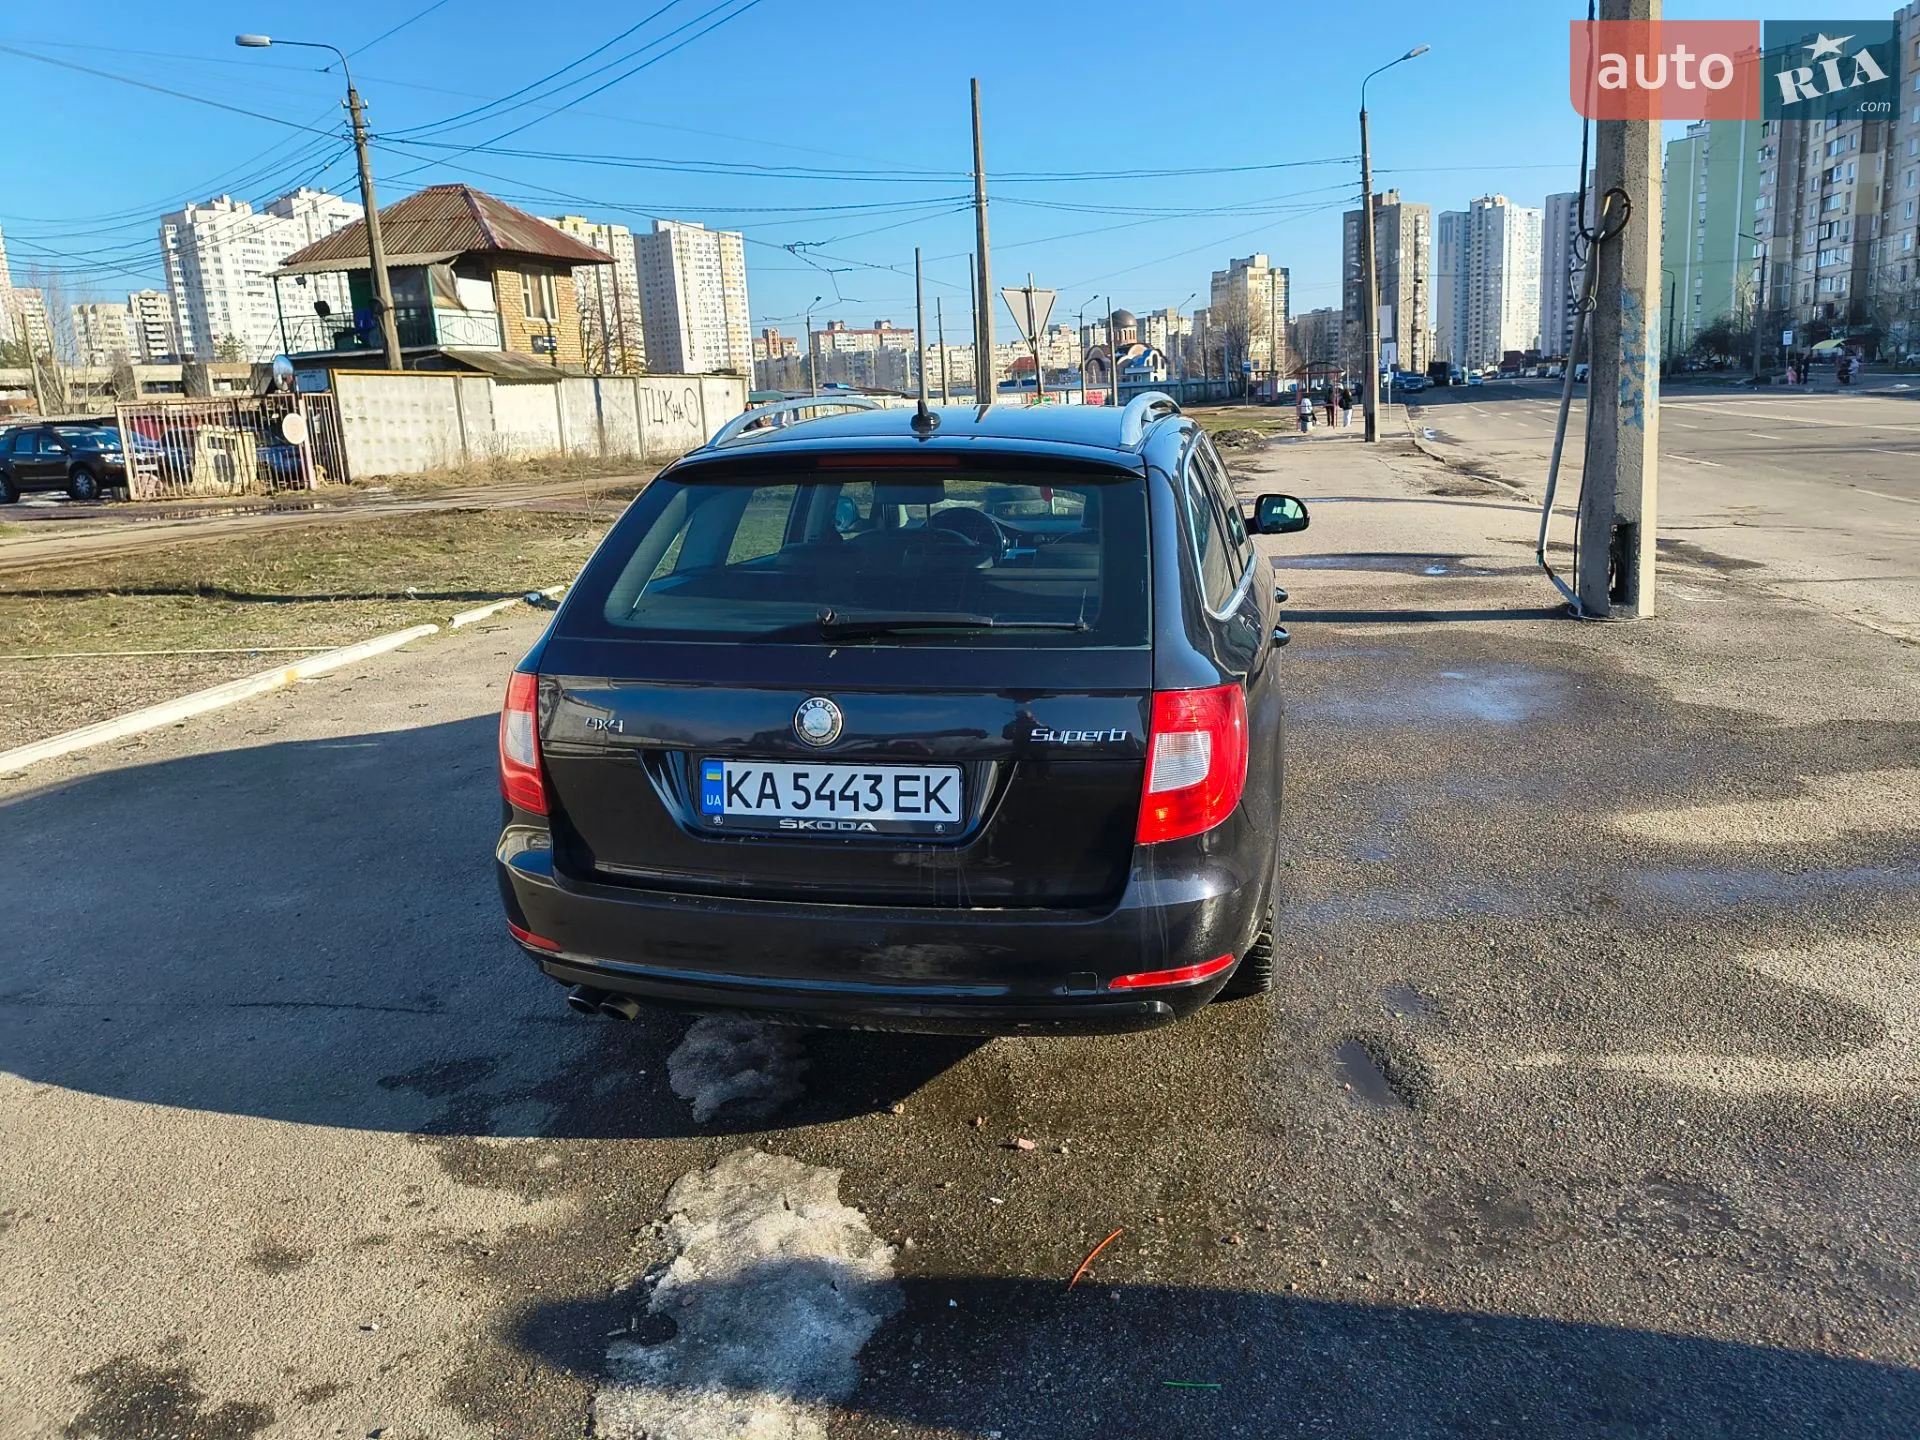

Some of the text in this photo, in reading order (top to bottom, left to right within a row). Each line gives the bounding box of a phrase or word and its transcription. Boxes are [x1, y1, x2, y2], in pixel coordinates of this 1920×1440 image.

[1030, 728, 1127, 744] Superb
[727, 770, 952, 814] KA 5443 EK
[706, 795, 722, 806] UA
